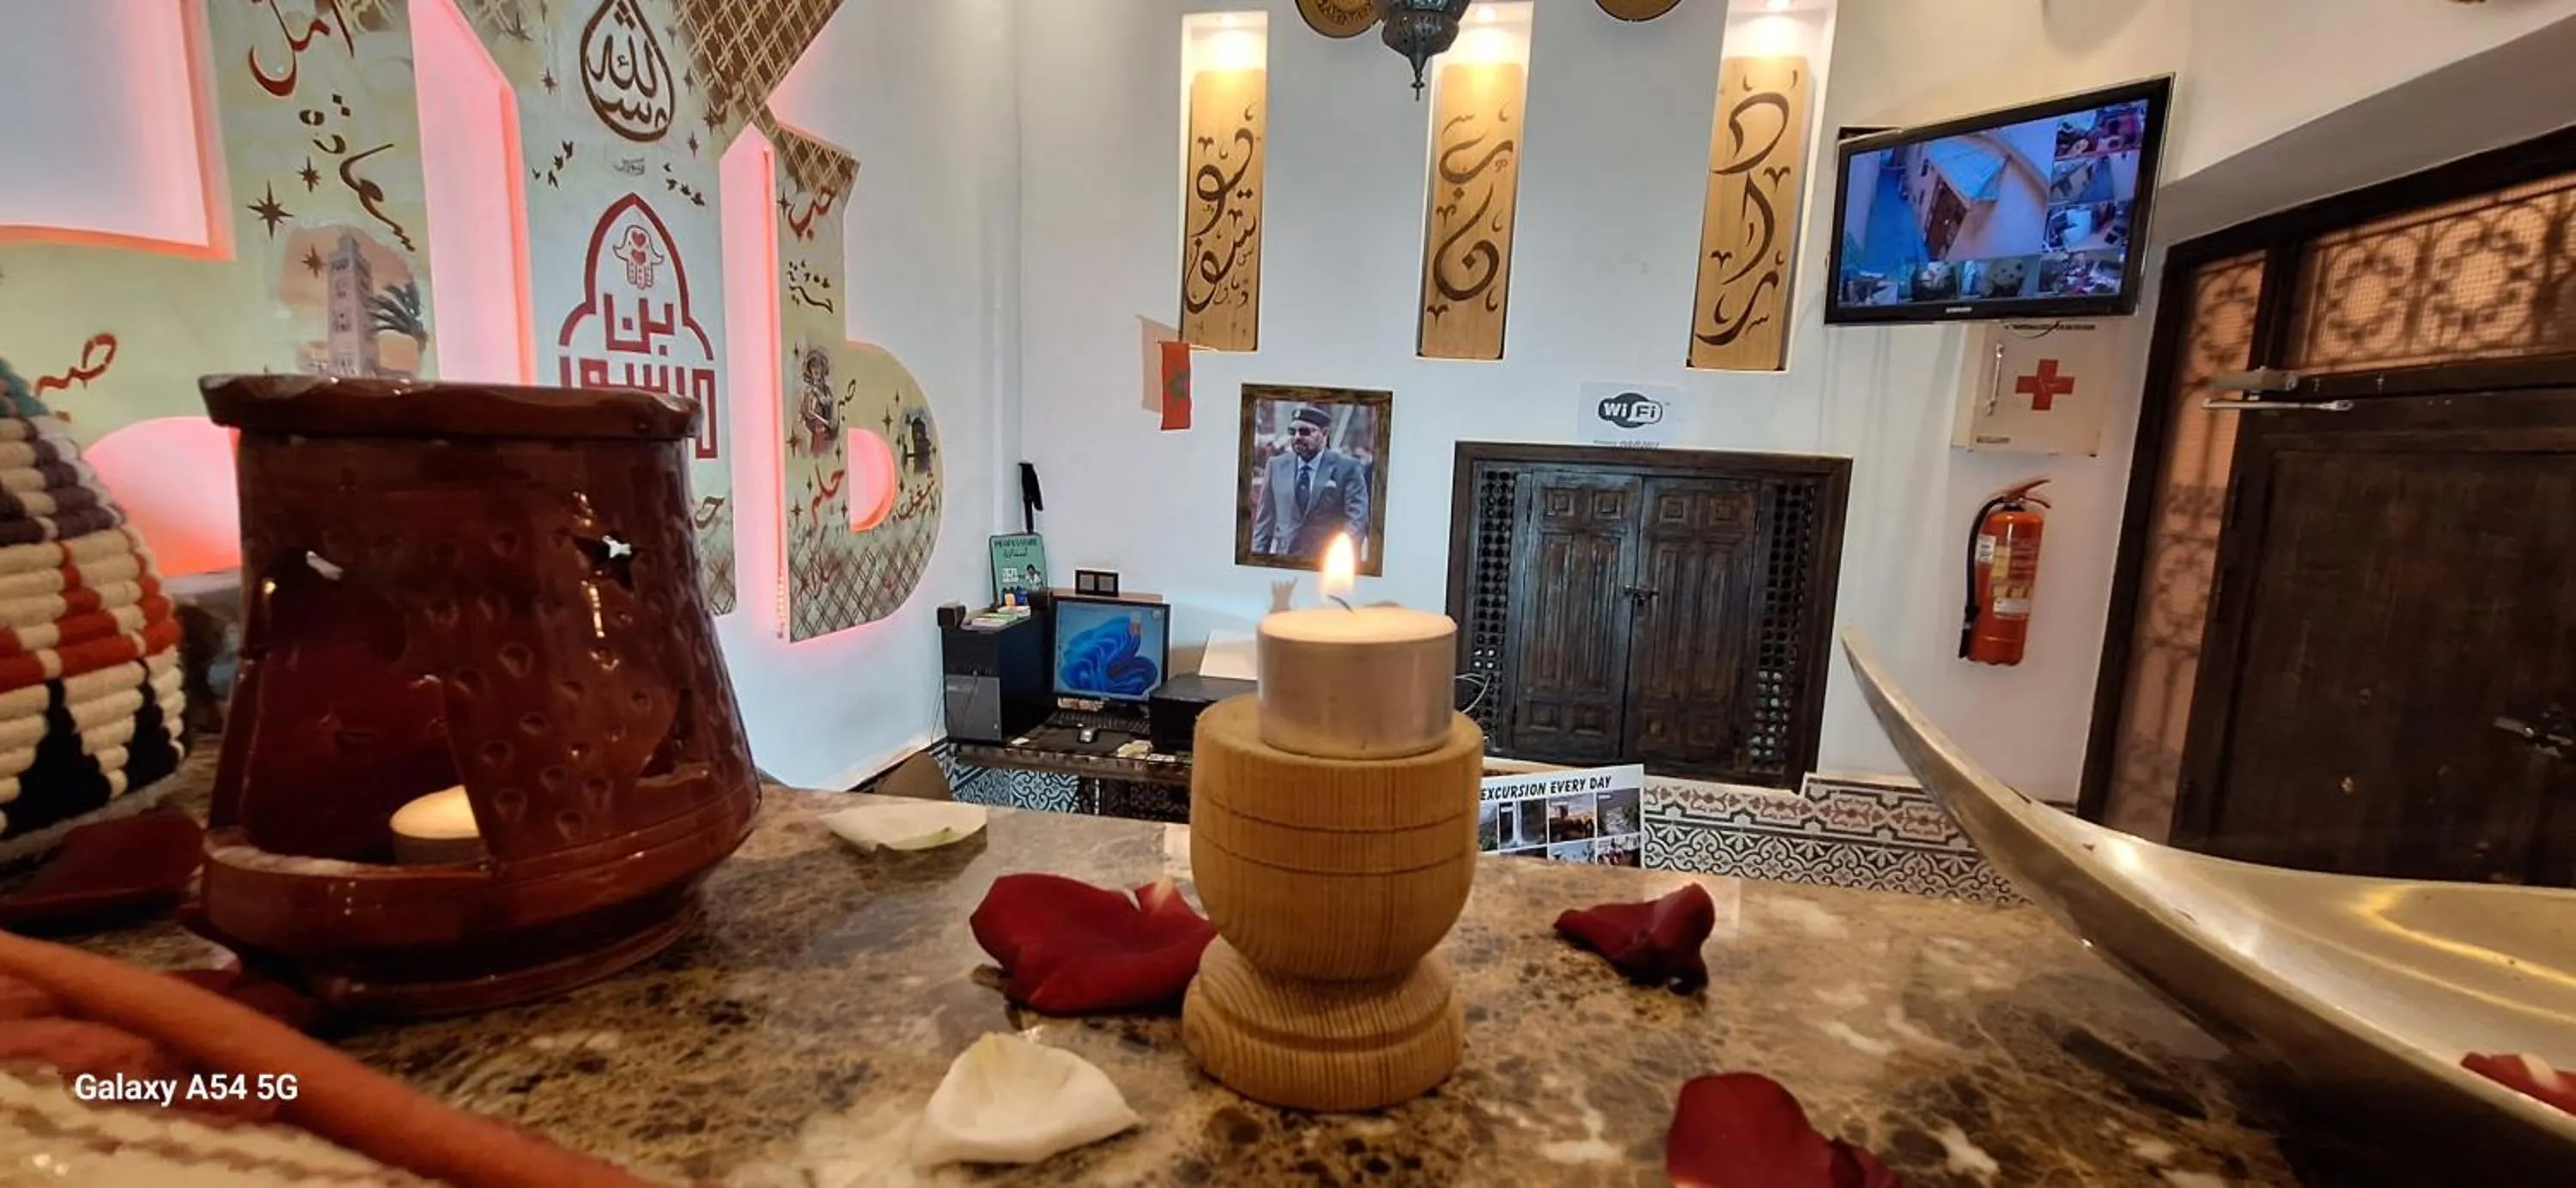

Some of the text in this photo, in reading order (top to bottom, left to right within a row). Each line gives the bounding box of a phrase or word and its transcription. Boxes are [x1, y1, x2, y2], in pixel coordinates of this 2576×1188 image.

[1480, 775, 1612, 801] EXCURSION EVERY DAY
